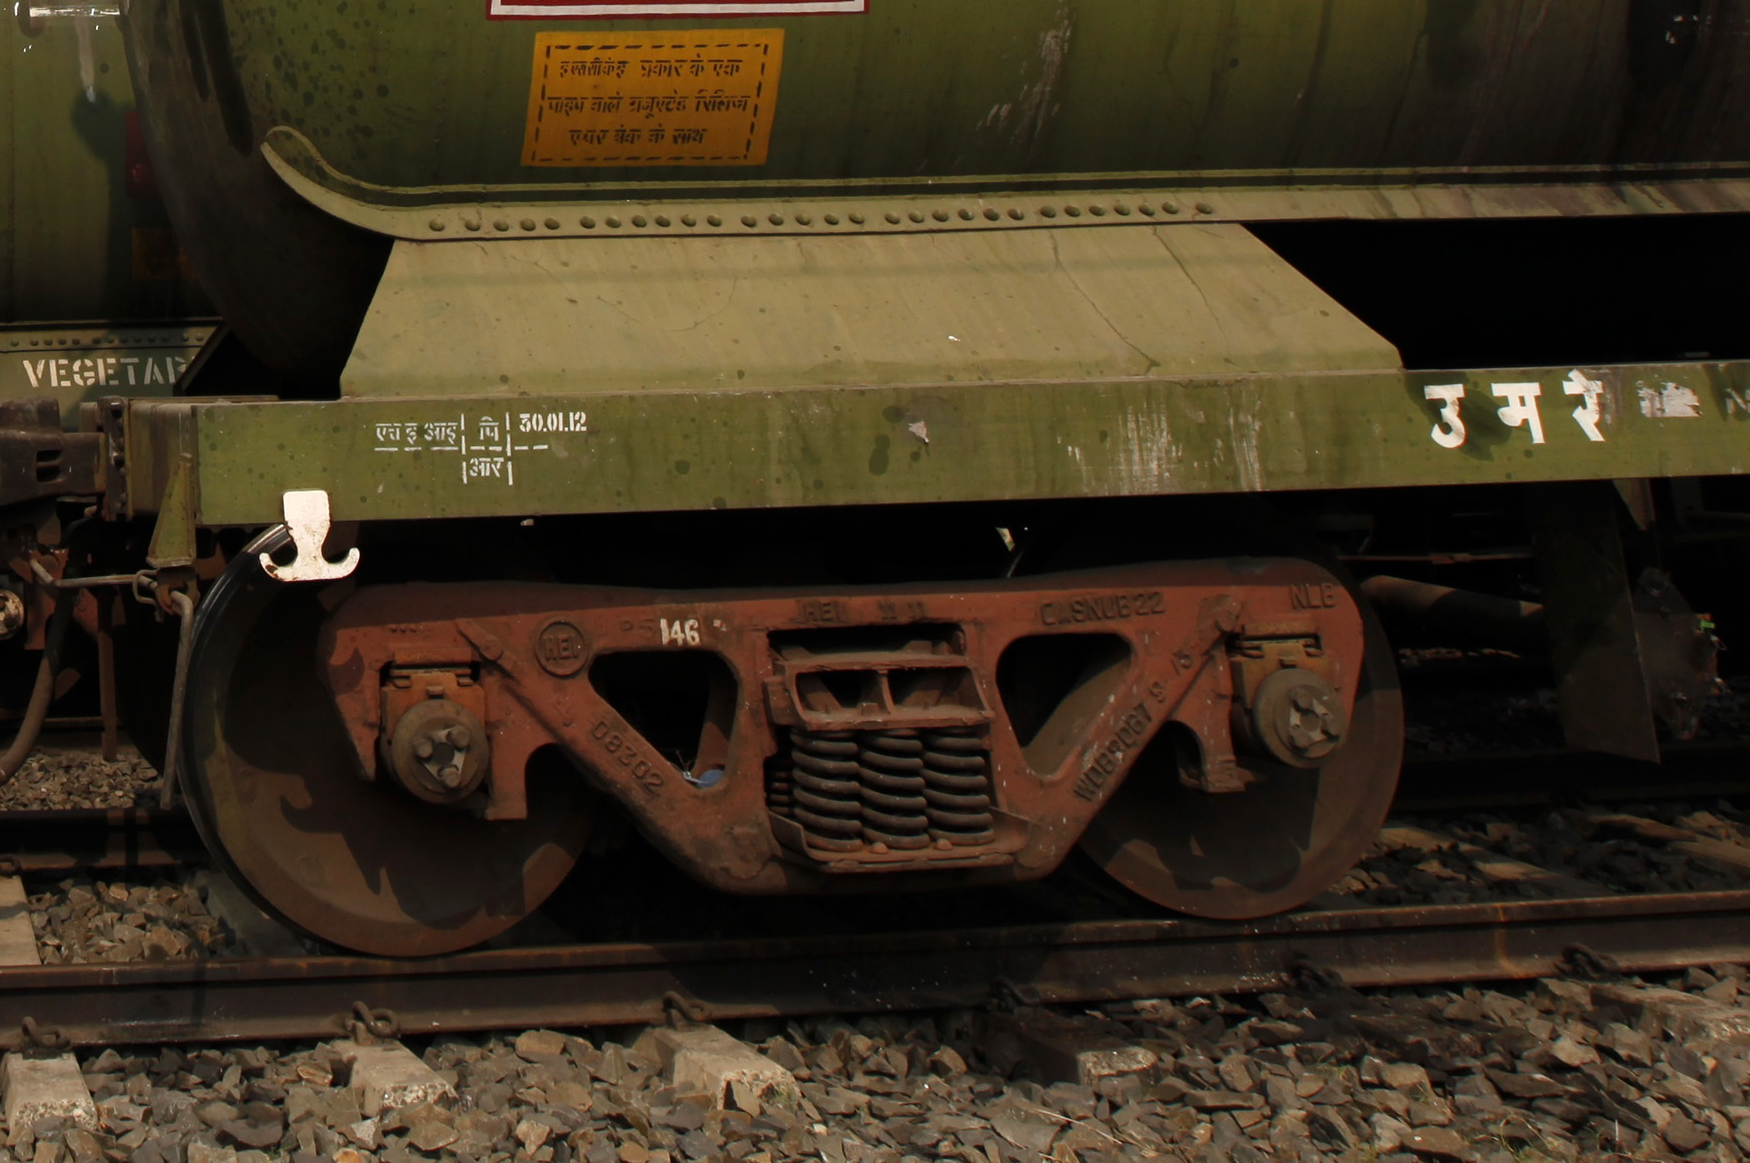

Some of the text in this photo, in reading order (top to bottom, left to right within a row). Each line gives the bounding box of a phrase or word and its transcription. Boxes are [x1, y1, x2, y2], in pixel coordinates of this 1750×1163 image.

[519, 411, 587, 432] 30.01.12
[1424, 383, 1466, 448] उ
[1490, 382, 1546, 444] म
[1562, 368, 1606, 442] रे
[1290, 583, 1338, 610] NLB
[660, 618, 700, 646] 146
[587, 716, 668, 797] 08302
